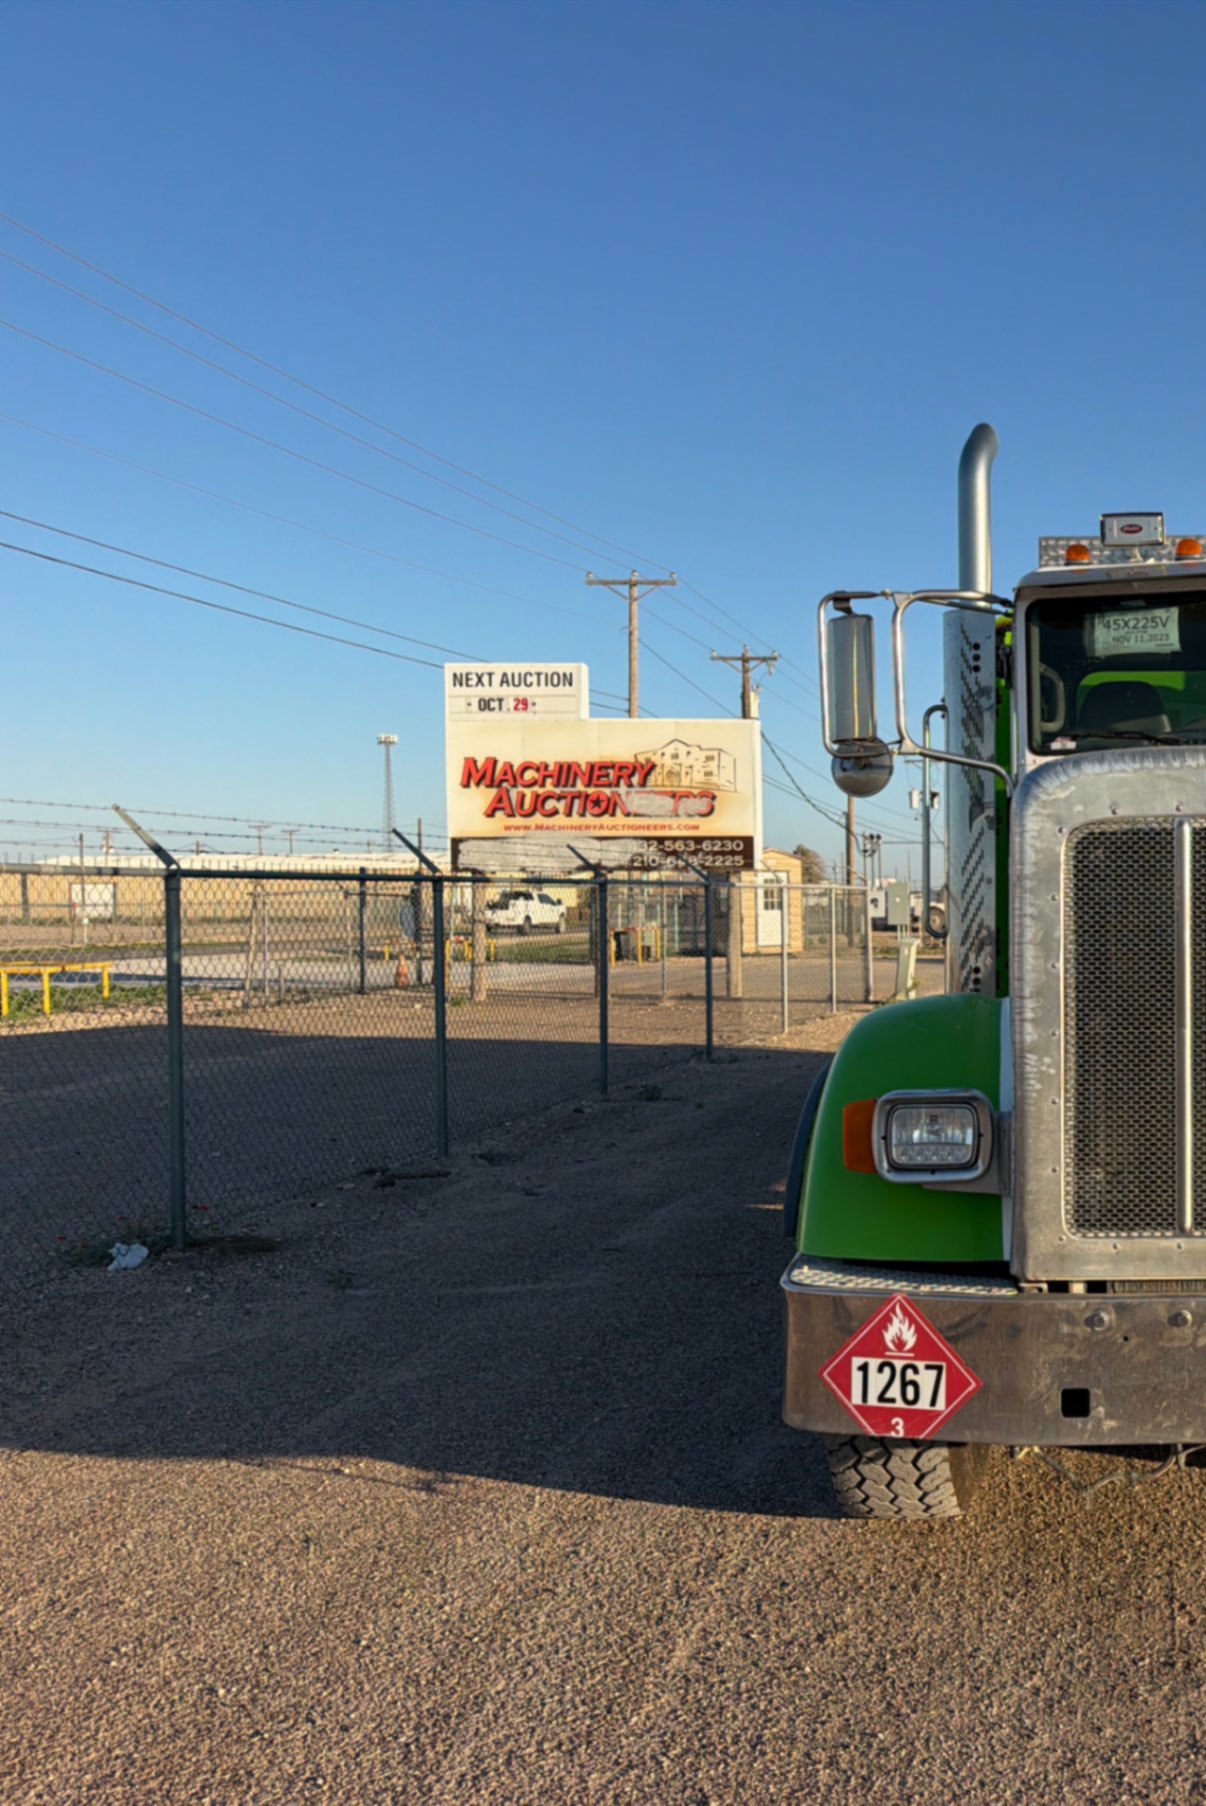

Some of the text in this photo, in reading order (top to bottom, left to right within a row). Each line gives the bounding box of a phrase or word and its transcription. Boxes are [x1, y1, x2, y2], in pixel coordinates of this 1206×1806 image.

[1111, 635, 1131, 645] NOV
[452, 671, 573, 688] NEXT AUCTION
[513, 697, 529, 712] 29
[460, 756, 656, 788] MACHINERY
[483, 787, 717, 818] AUCTIONRS
[635, 839, 744, 851] 32-563-6230
[857, 1360, 944, 1408] 1267
[890, 1417, 904, 1437] 3
